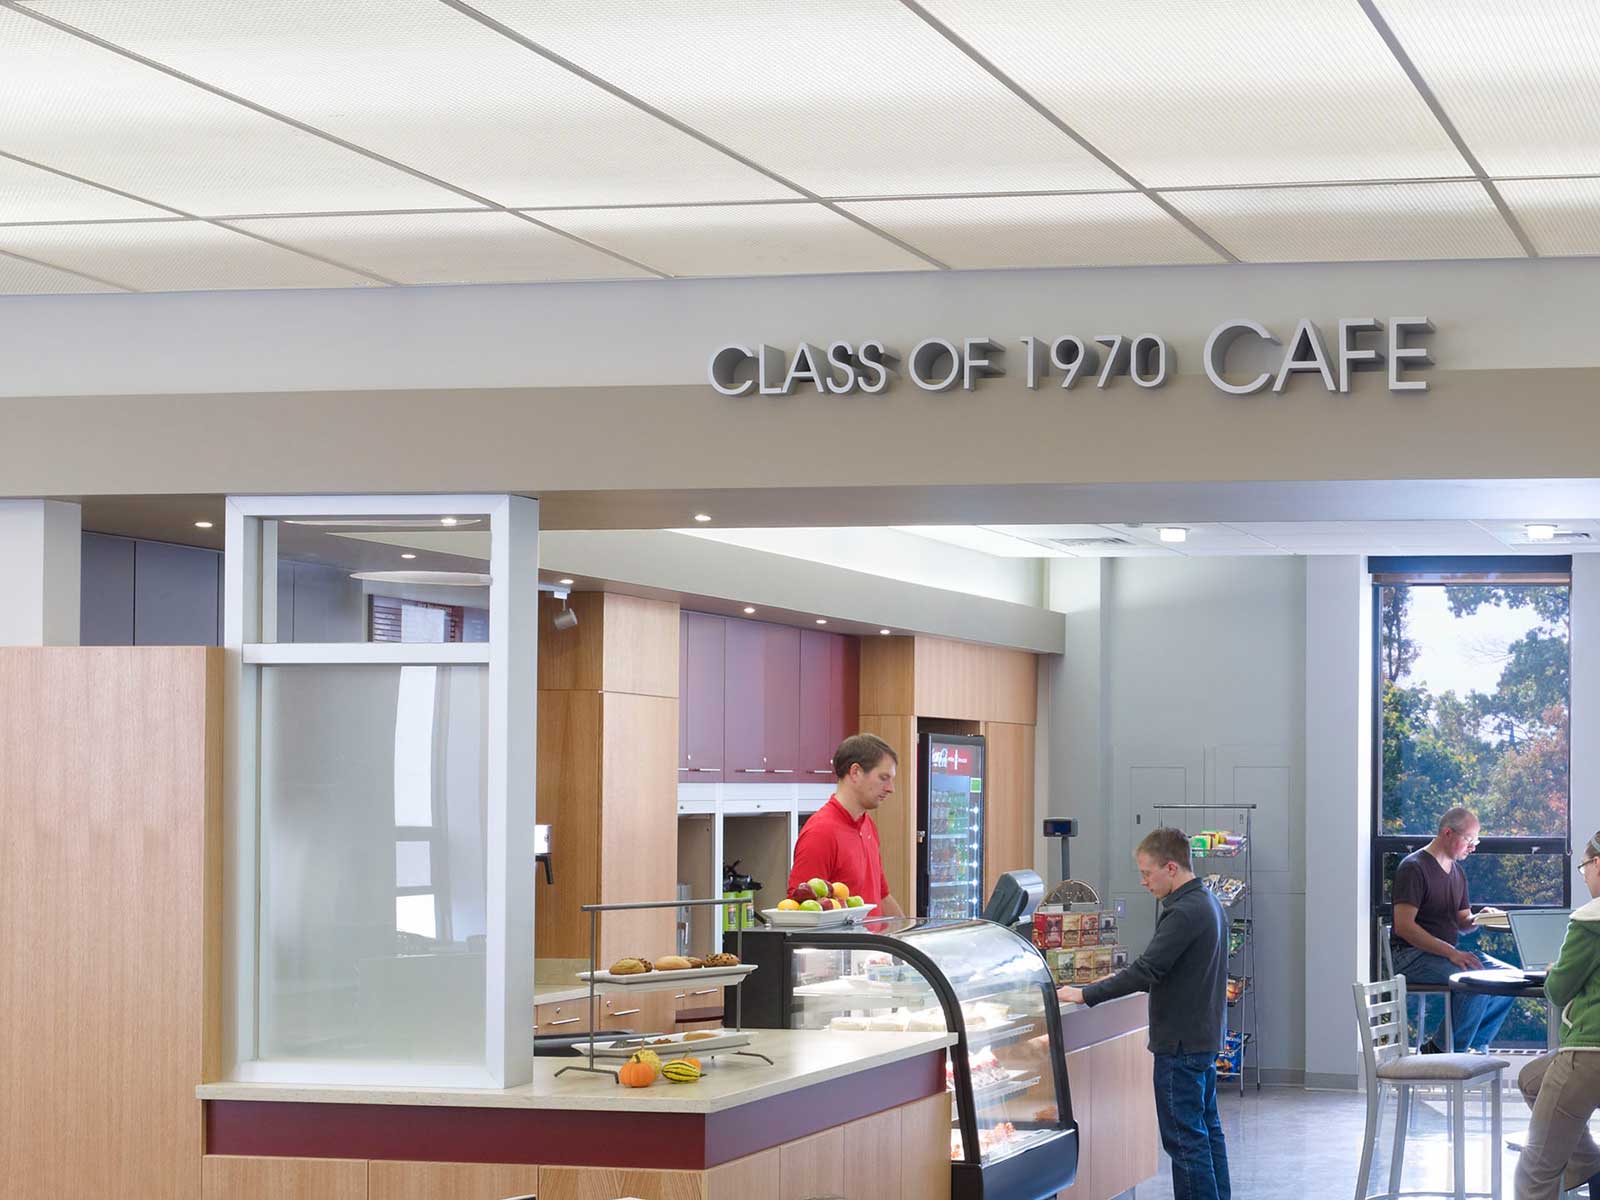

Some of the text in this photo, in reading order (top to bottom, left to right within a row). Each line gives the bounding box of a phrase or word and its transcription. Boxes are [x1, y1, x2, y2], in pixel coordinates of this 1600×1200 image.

[707, 316, 1434, 397] CLASS OF 1970 CAFE
